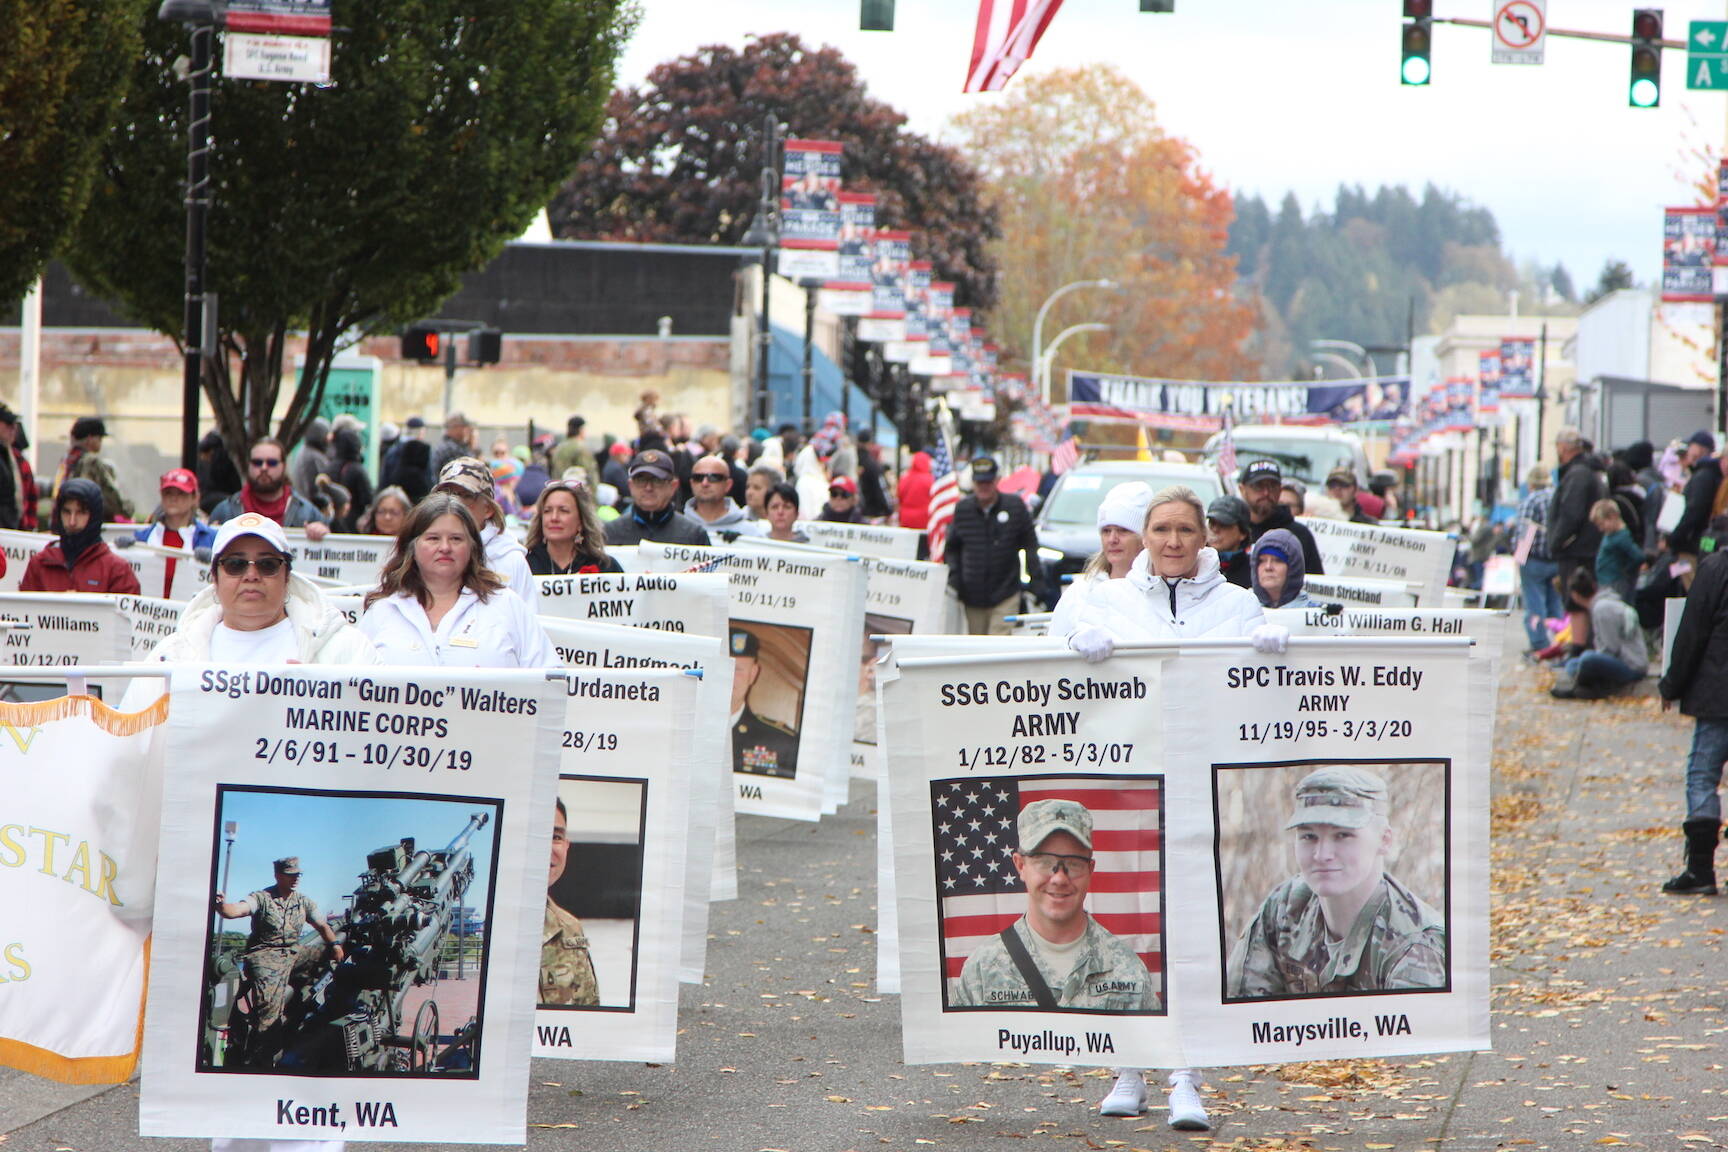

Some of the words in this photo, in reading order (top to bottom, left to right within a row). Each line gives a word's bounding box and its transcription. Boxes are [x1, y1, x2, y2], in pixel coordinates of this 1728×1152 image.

[1695, 60, 1712, 87] A
[1099, 377, 1163, 411] THANK
[1166, 385, 1204, 414] YOU
[1379, 532, 1427, 552] Jackson
[304, 548, 322, 561] Paul
[323, 548, 356, 561] Vincent
[356, 549, 378, 562] Elder
[664, 546, 691, 561] SFC
[776, 559, 827, 578] Parmar
[318, 565, 341, 579] ARMY
[876, 562, 929, 581] Crawford
[541, 578, 574, 597] SGT
[580, 576, 612, 595] Eric
[616, 575, 630, 593] J.
[635, 573, 678, 592] Autio
[132, 600, 179, 621] Keigan
[586, 600, 635, 618] ARMY
[738, 590, 797, 609] 10/11/19
[38, 615, 99, 633] Williams
[135, 620, 155, 634] AIR
[1305, 612, 1344, 629] LtCol
[1348, 613, 1407, 632] William
[1411, 617, 1428, 632] G.
[1431, 617, 1464, 634] Hall
[6, 634, 31, 647] AVY
[12, 653, 79, 666] 10/12/07
[566, 675, 661, 702] Urdaneta
[1227, 666, 1271, 689] SPC
[1275, 665, 1336, 687] Travis
[1340, 666, 1367, 687] W.
[1372, 666, 1424, 691] Eddy
[200, 670, 250, 699] SSgt
[255, 671, 343, 700] Donovan
[460, 687, 538, 717] Walters
[940, 682, 990, 707] SSG
[996, 679, 1052, 707] Coby
[1057, 676, 1148, 701] Schwab
[1298, 695, 1351, 712] ARMY
[286, 707, 371, 733] MARINE
[375, 713, 449, 739] CORPS
[1011, 711, 1081, 738] ARMY
[1238, 720, 1329, 745] 11/19/95
[1342, 720, 1413, 742] 3/3/20
[561, 730, 619, 753] 28/19
[254, 737, 341, 767] 2/6/91
[362, 742, 474, 773] 10/30/19
[958, 744, 1046, 771] 1/12/82
[1062, 742, 1134, 767] 5/3/07
[739, 784, 763, 801] WA
[537, 1025, 573, 1048] WA
[1251, 1018, 1369, 1047] Marysville,
[1374, 1014, 1412, 1037] WA
[998, 1029, 1081, 1057] Puyallup,
[1086, 1032, 1115, 1054] WA
[276, 1099, 347, 1133] Kent,
[354, 1101, 399, 1128] WA
